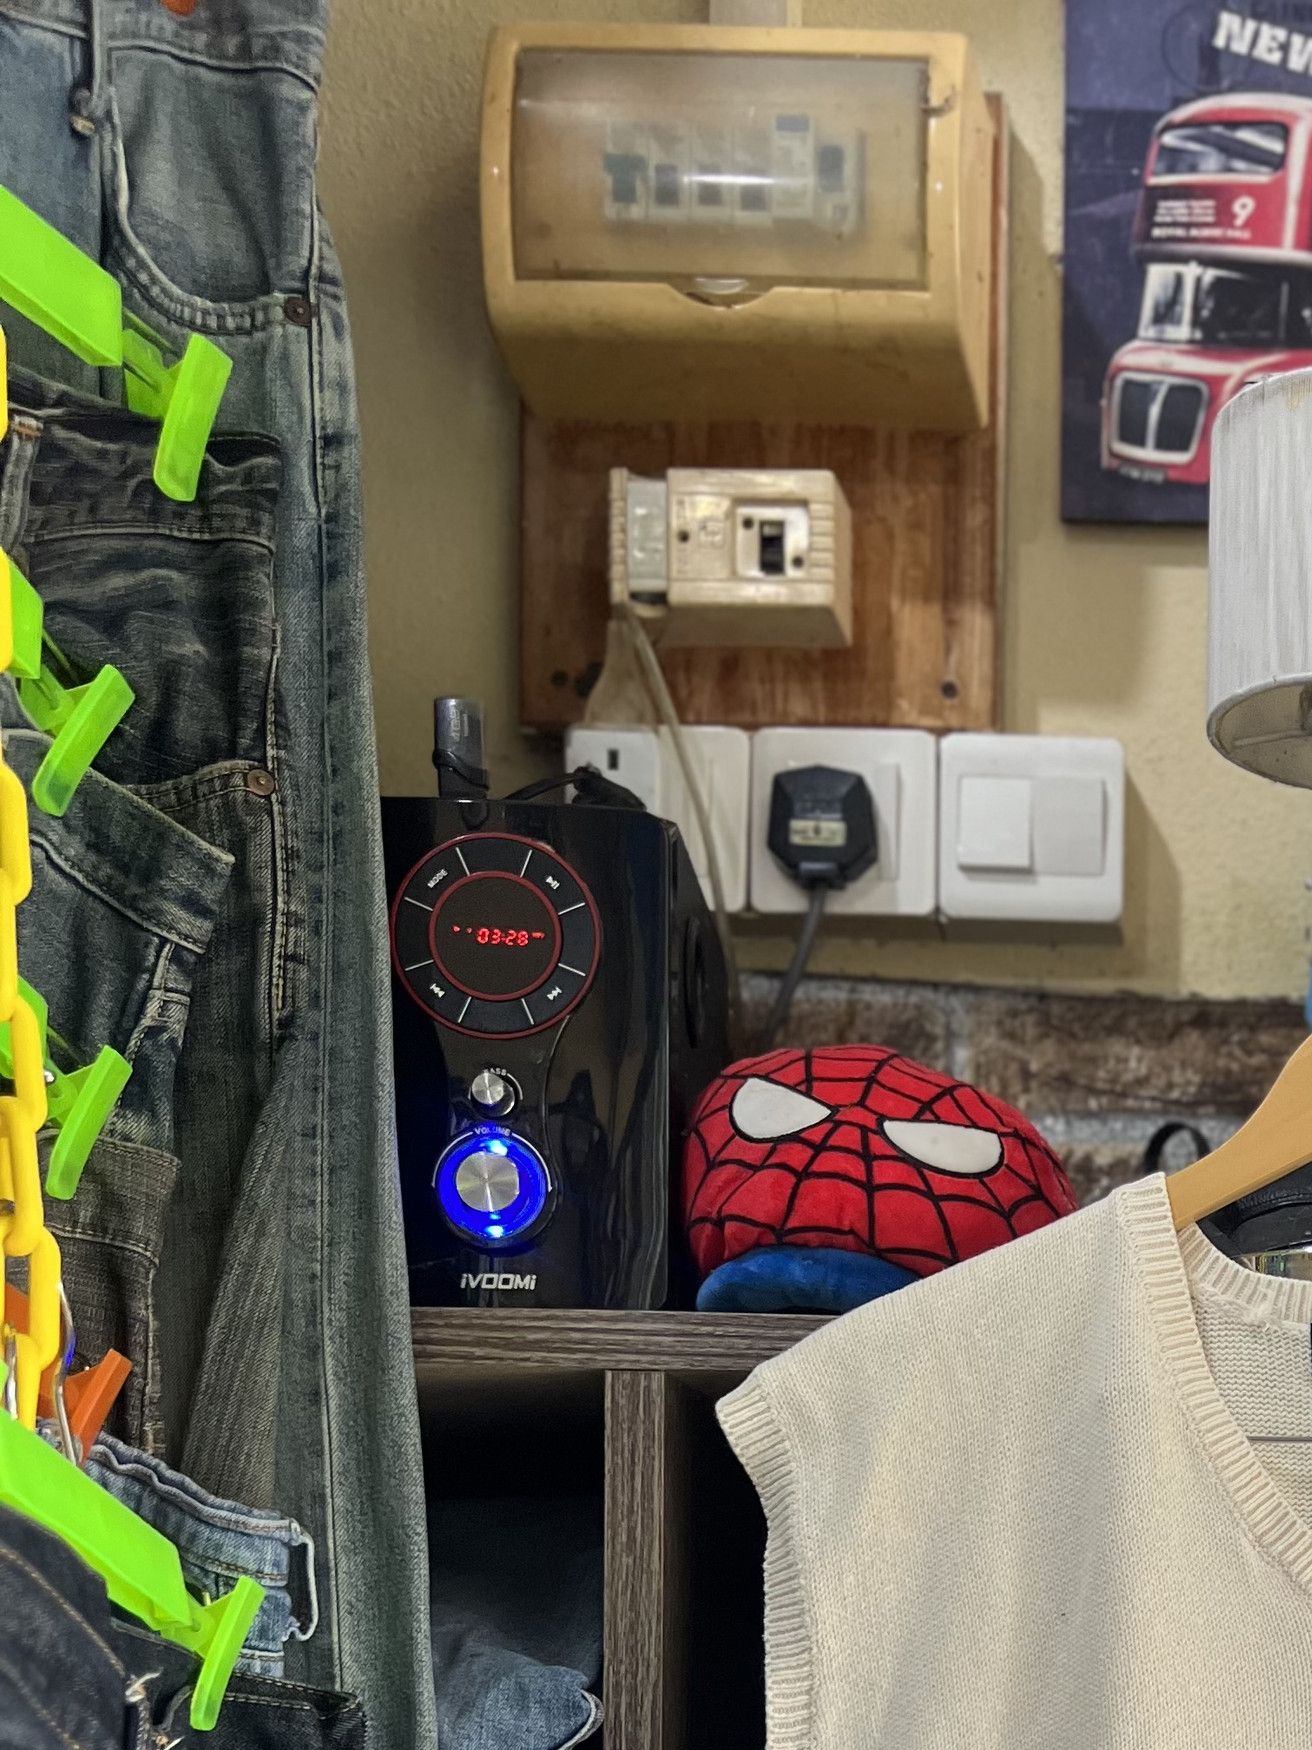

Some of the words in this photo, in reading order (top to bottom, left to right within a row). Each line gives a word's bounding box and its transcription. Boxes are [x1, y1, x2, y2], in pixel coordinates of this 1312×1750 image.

[1231, 195, 1255, 227] 9
[427, 868, 448, 888] MODE
[474, 1126, 511, 1137] VOLUME
